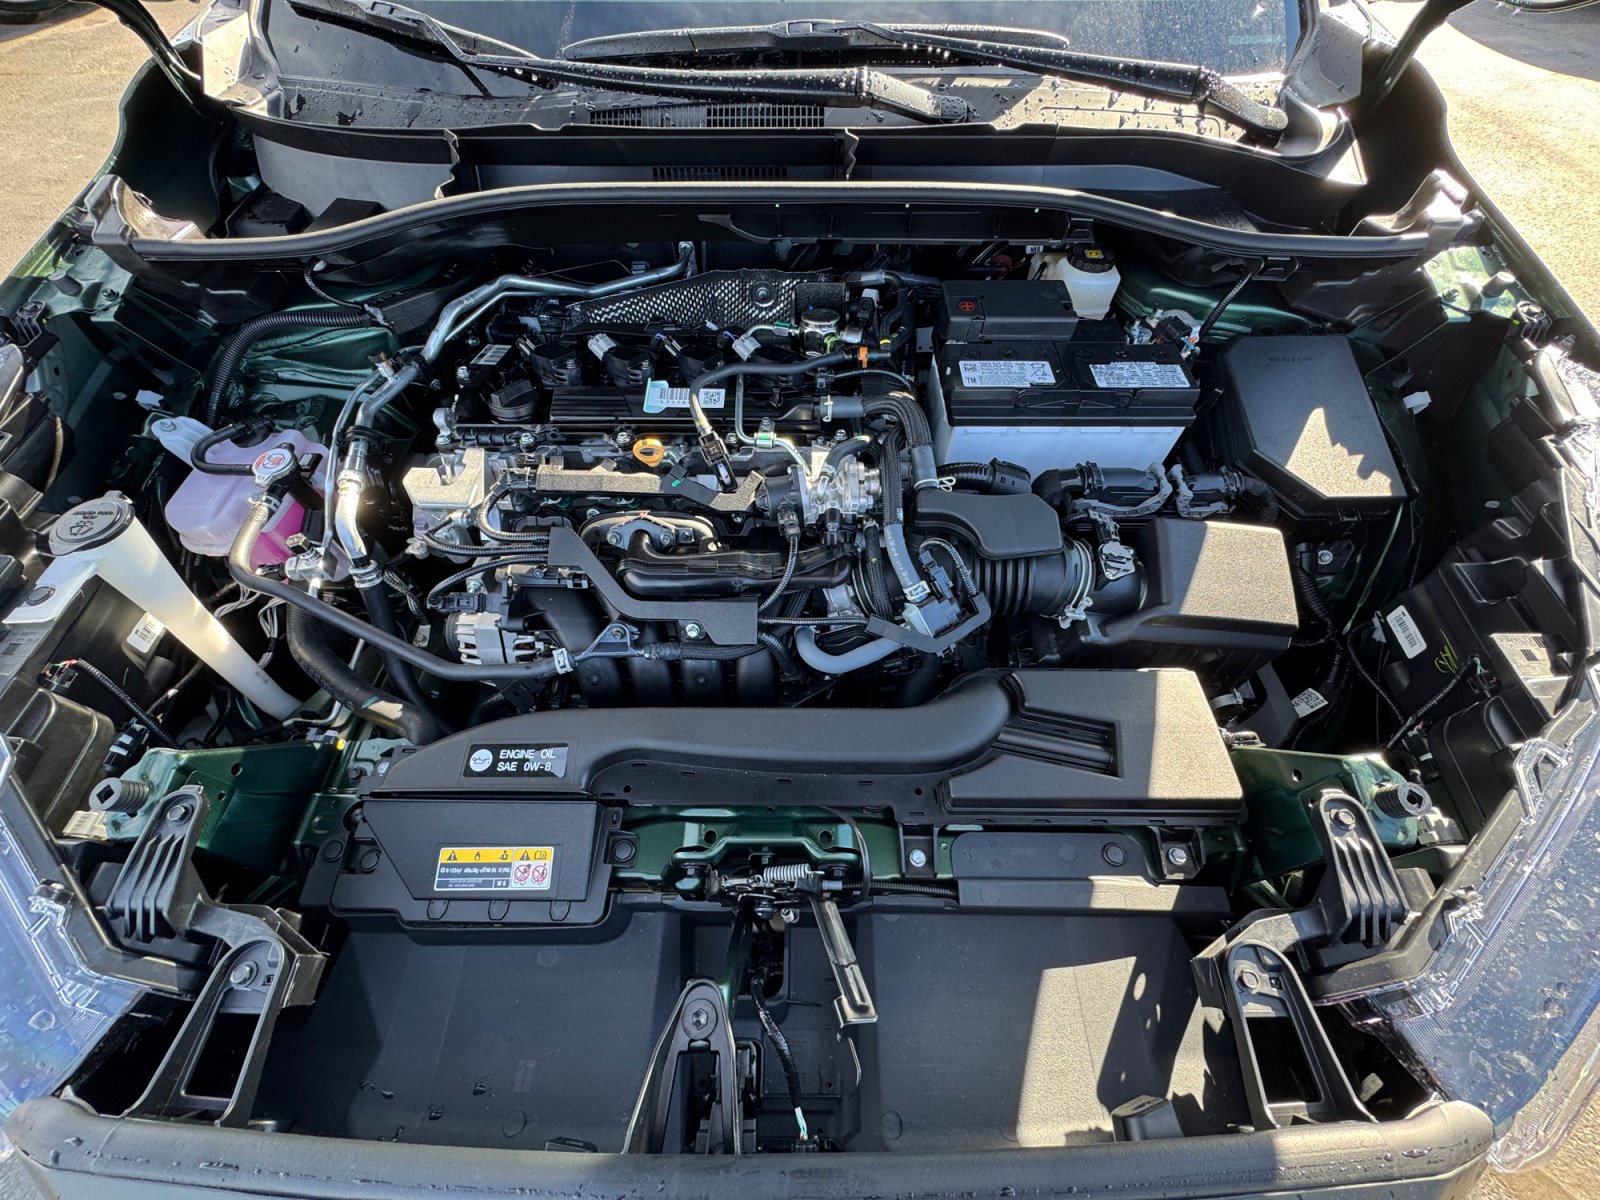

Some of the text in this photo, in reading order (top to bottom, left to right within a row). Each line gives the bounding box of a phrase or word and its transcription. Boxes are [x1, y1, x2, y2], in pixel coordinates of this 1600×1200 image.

[499, 749, 556, 759] ENGINE OIL
[497, 761, 551, 772] SAE 0W-8
